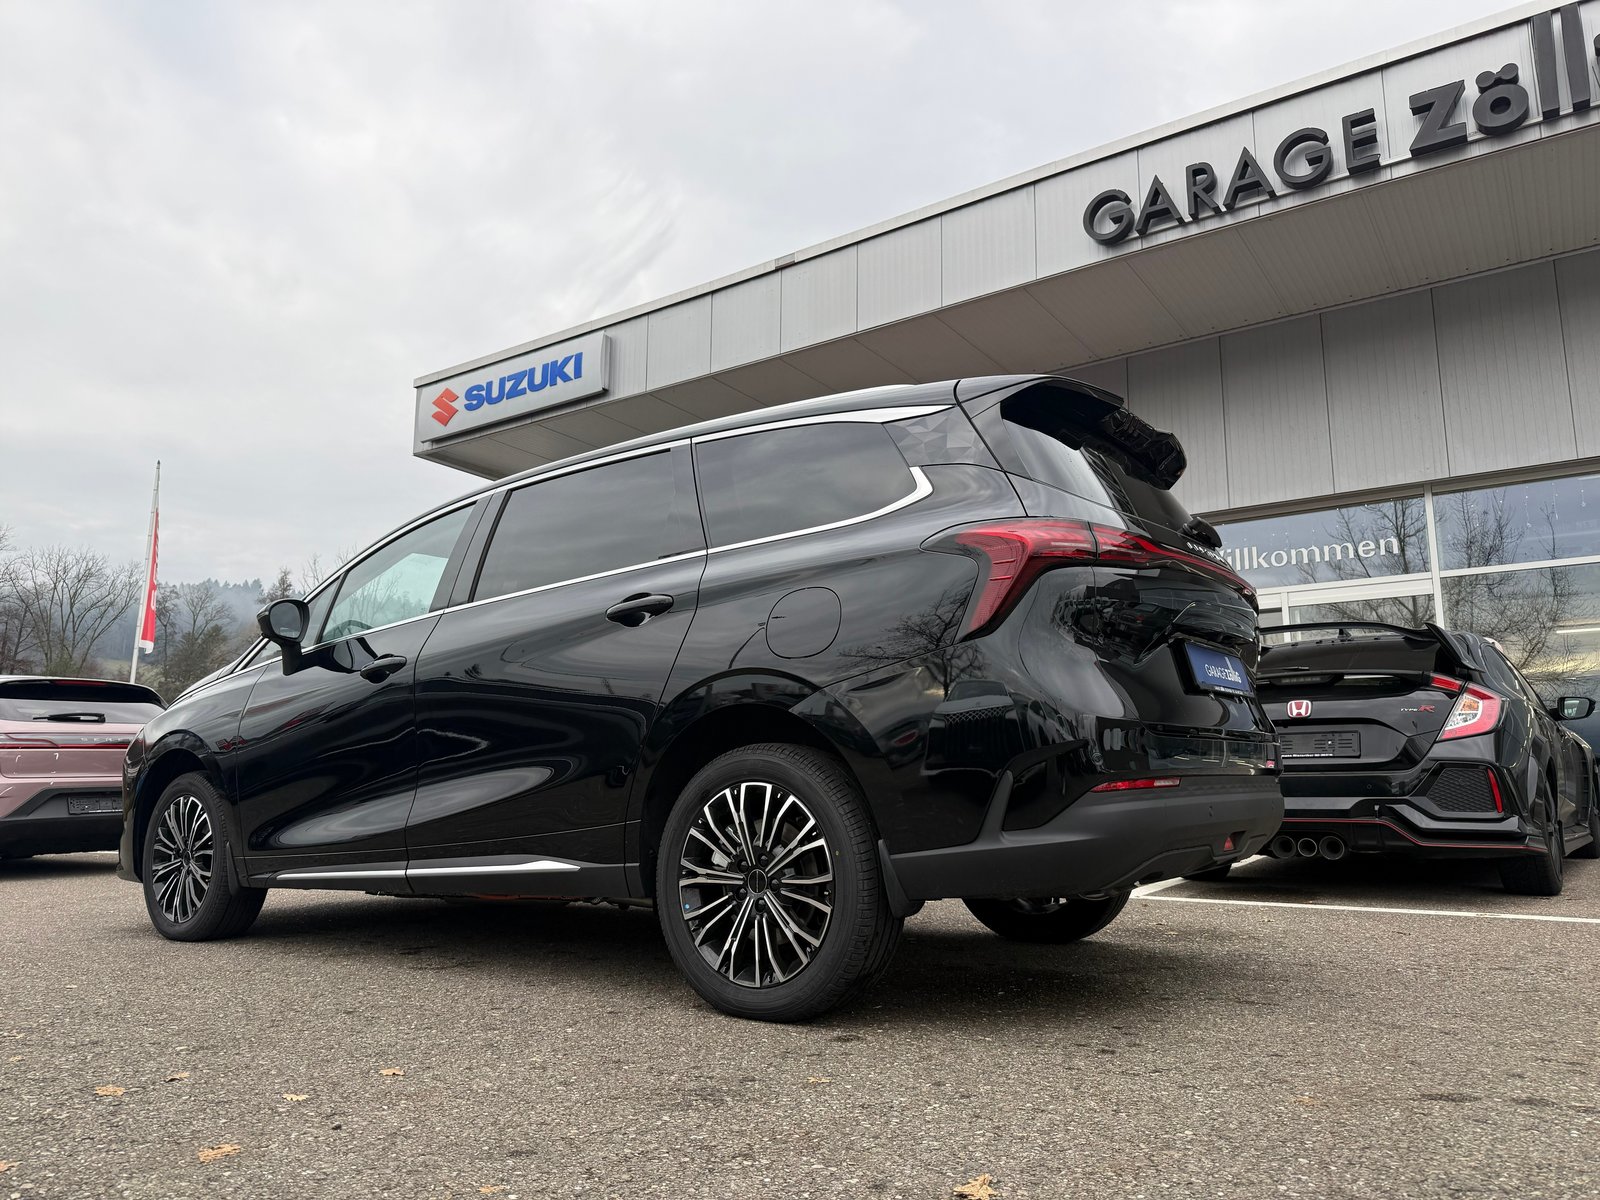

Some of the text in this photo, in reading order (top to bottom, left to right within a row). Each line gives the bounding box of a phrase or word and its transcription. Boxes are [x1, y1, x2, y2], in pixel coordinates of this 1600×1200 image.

[1083, 108, 1381, 245] GARAGE
[464, 352, 583, 412] SUZUKI
[1219, 536, 1399, 571] illkommen
